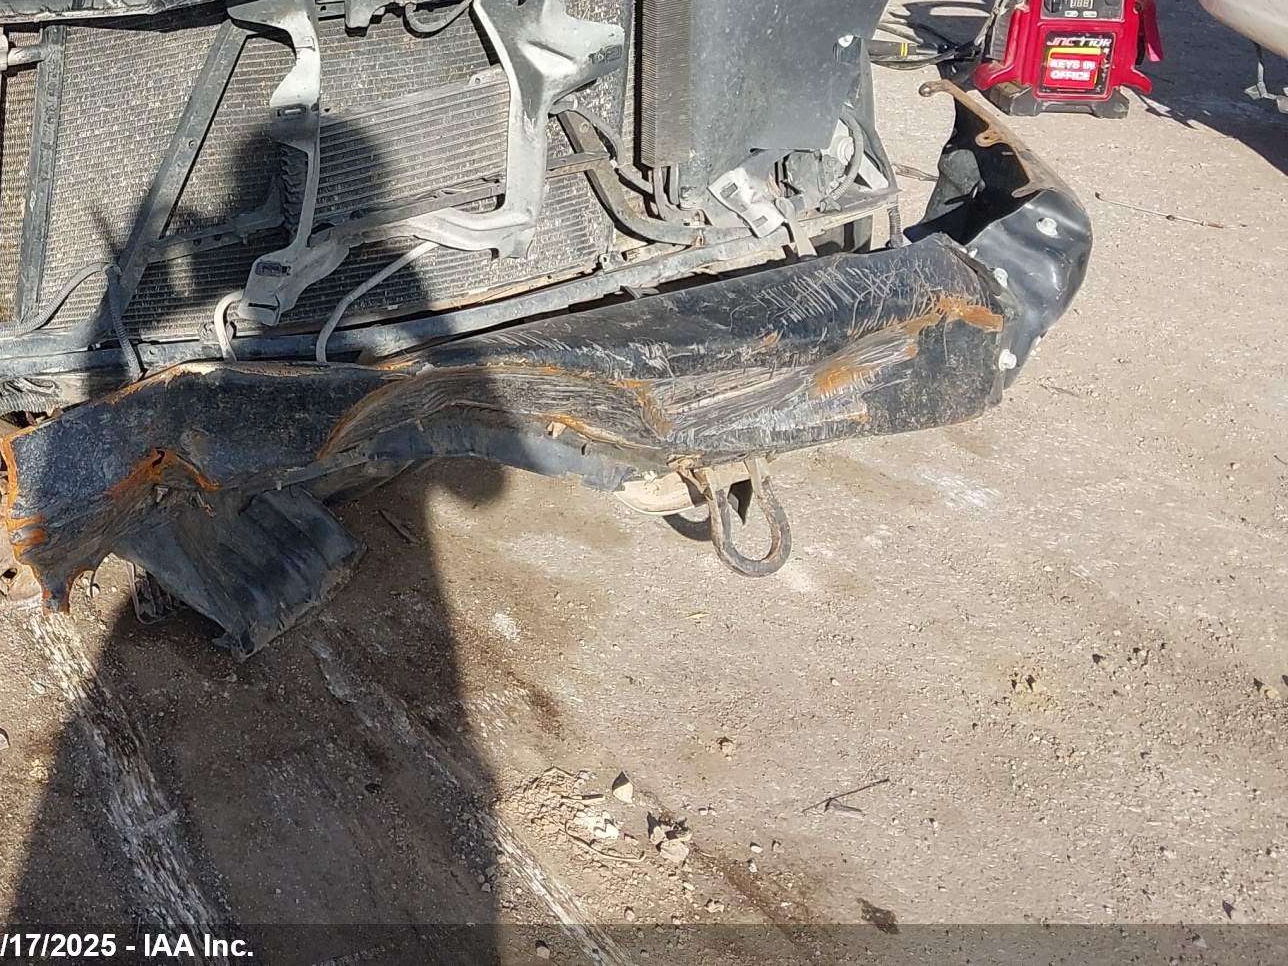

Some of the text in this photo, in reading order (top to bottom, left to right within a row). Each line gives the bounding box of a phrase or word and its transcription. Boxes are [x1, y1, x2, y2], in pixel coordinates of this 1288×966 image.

[1050, 59, 1096, 70] KEYS IN
[1050, 70, 1091, 81] OFFICE
